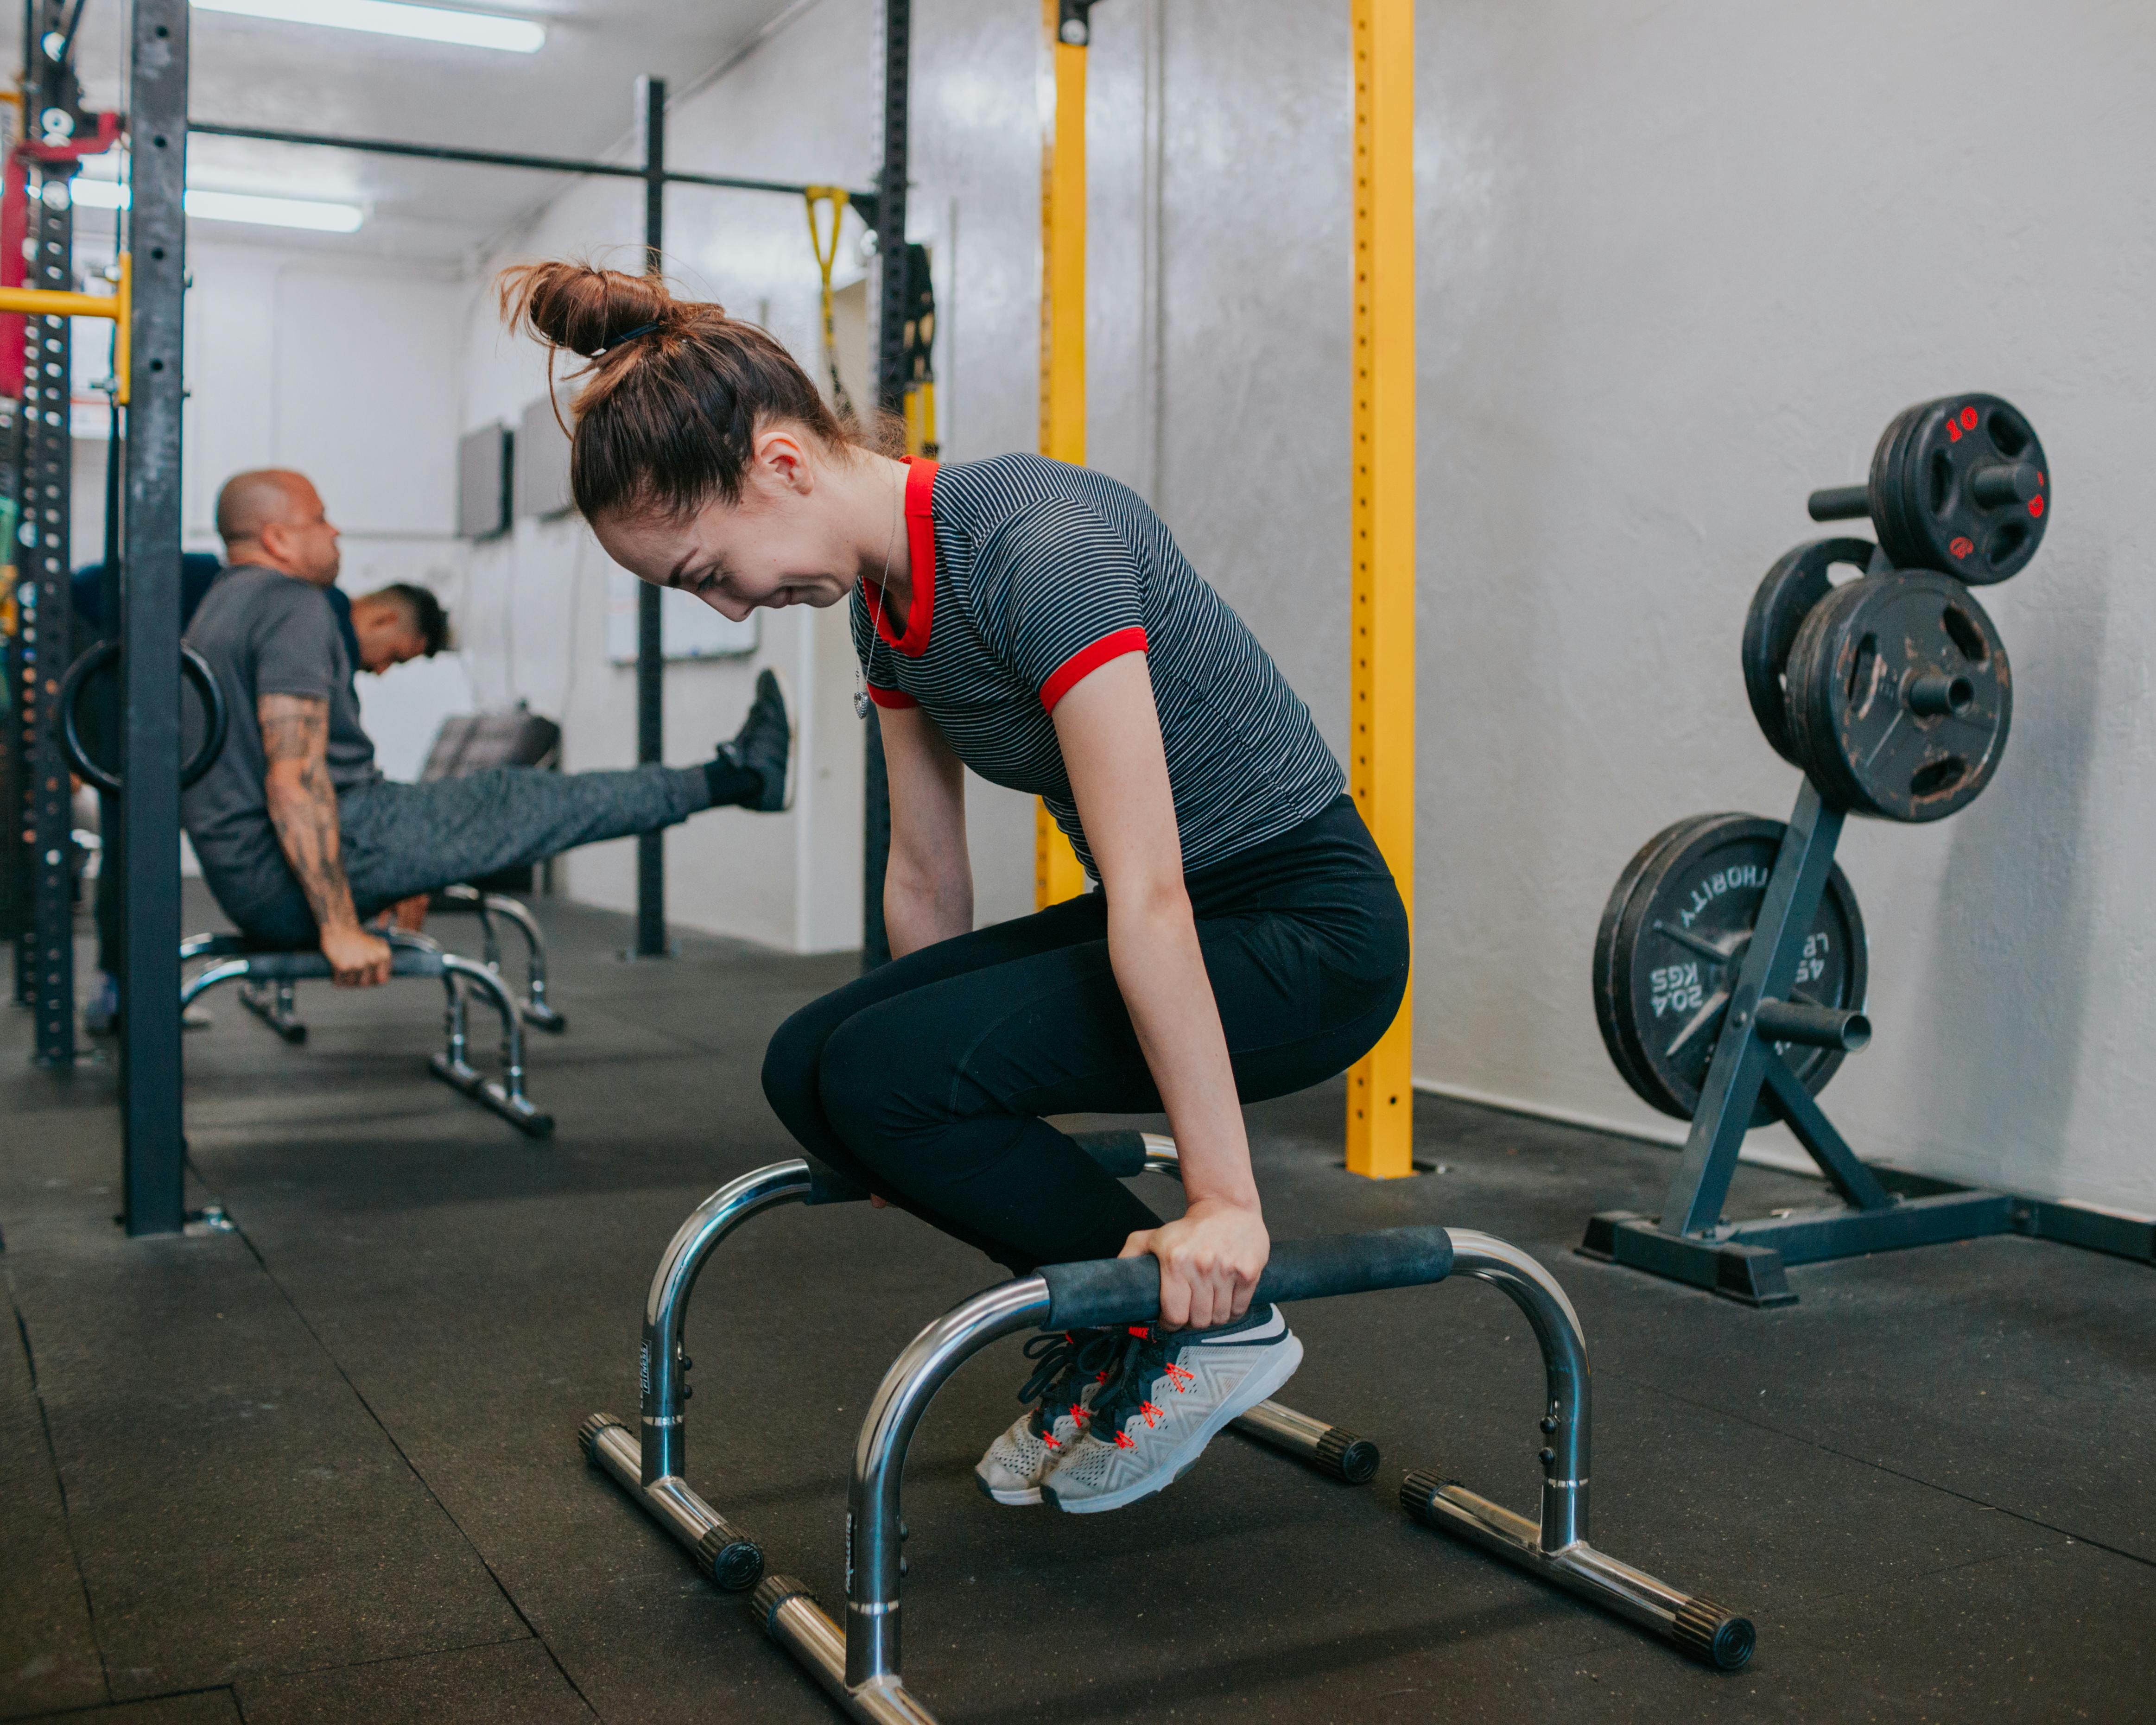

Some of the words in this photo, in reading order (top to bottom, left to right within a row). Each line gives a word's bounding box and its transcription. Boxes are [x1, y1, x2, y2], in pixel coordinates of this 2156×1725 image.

[1946, 406, 1978, 442] 10
[1680, 865, 1768, 928] THORITY
[1803, 932, 1829, 958] LB
[1650, 962, 1699, 993] KGS
[1651, 984, 1703, 1018] 20.4
